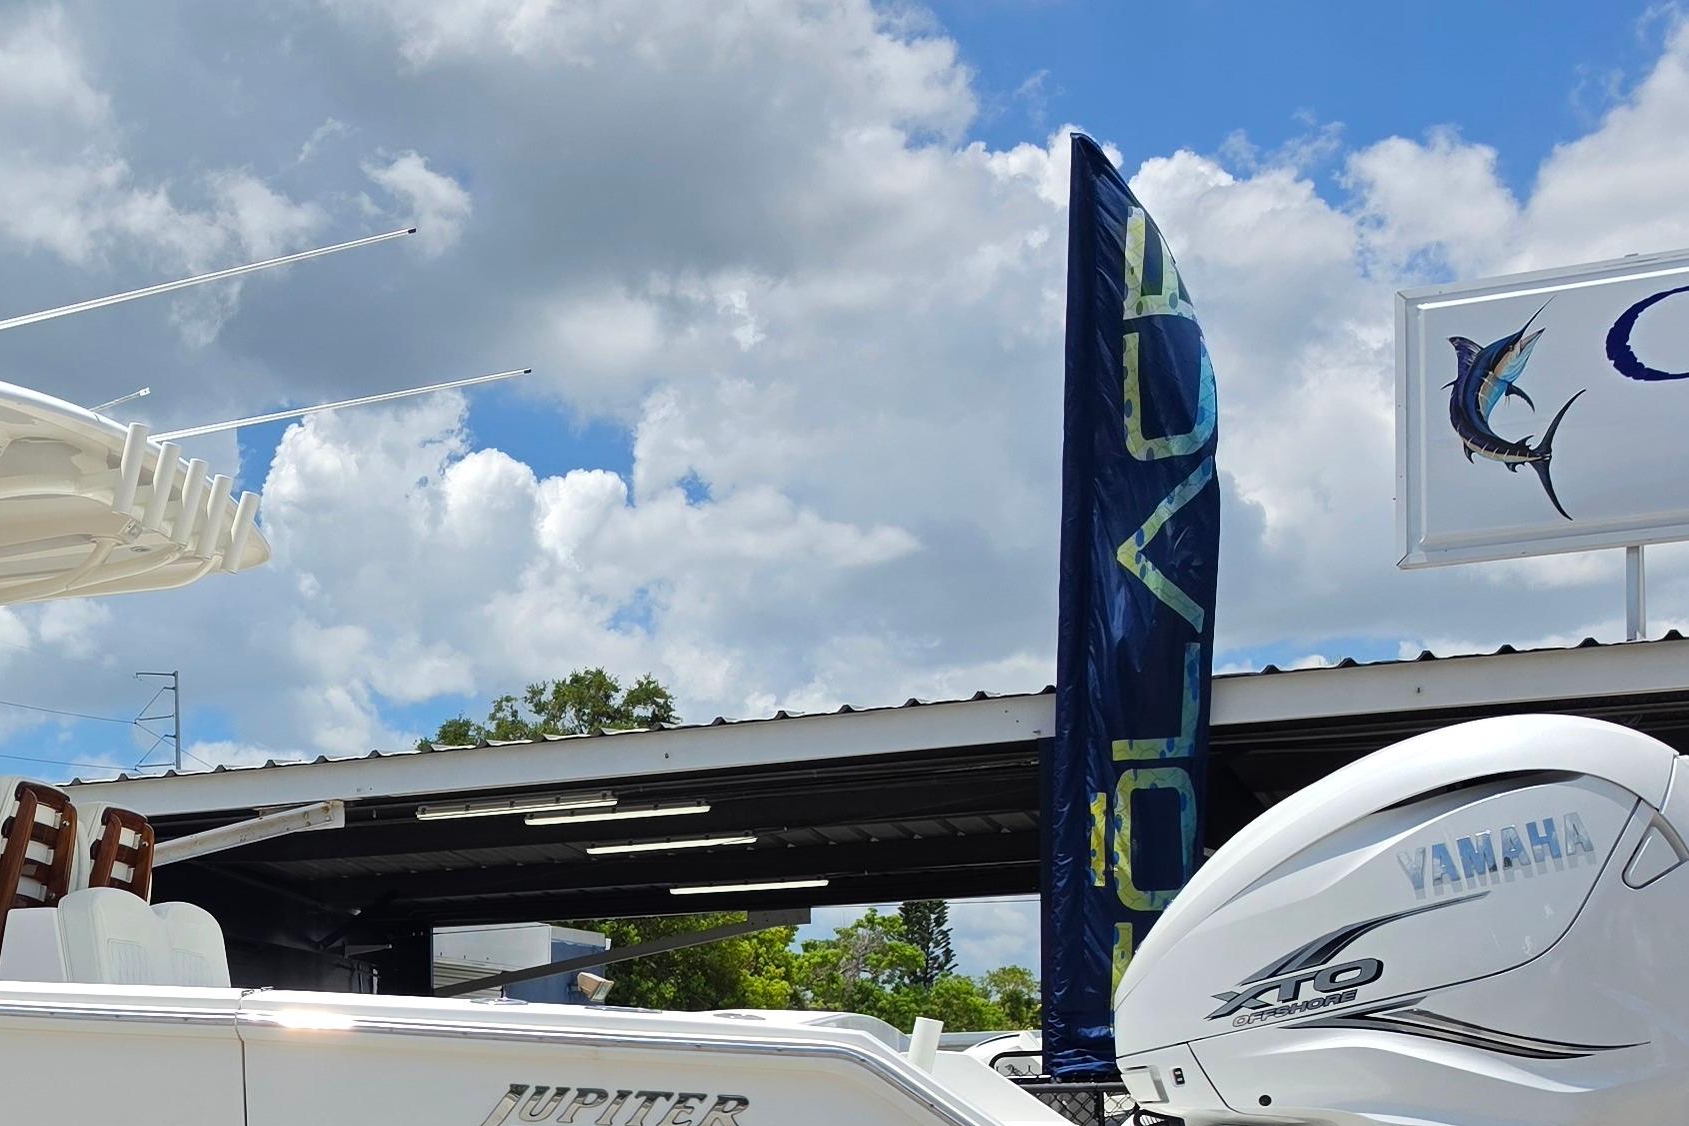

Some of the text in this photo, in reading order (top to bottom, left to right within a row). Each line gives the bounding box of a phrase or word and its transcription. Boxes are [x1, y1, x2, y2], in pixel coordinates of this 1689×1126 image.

[1397, 811, 1595, 896] YAMAHA
[1205, 957, 1384, 1020] XTO
[1233, 988, 1358, 1028] OFFSHORE
